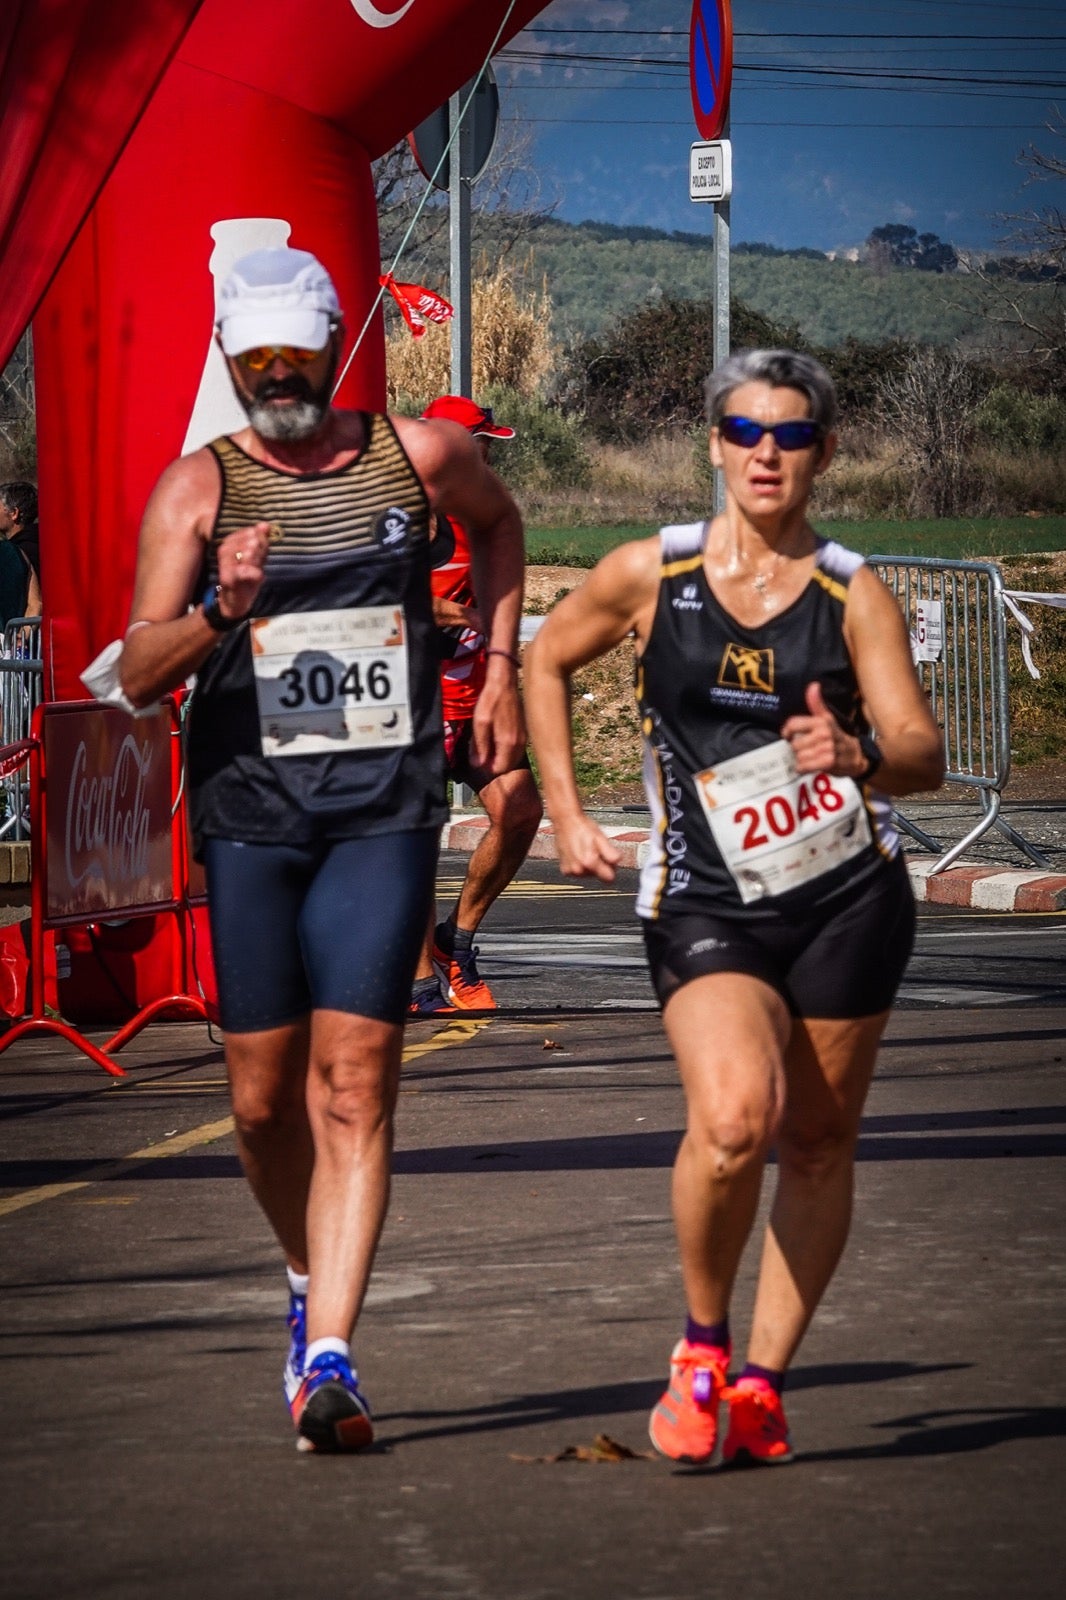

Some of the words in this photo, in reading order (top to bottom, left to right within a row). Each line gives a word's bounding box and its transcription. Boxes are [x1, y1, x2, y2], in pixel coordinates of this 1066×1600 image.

[698, 156, 716, 169] EXCEPTO
[708, 174, 721, 188] LOCAL
[278, 660, 391, 709] 3046
[733, 771, 845, 852] 2048
